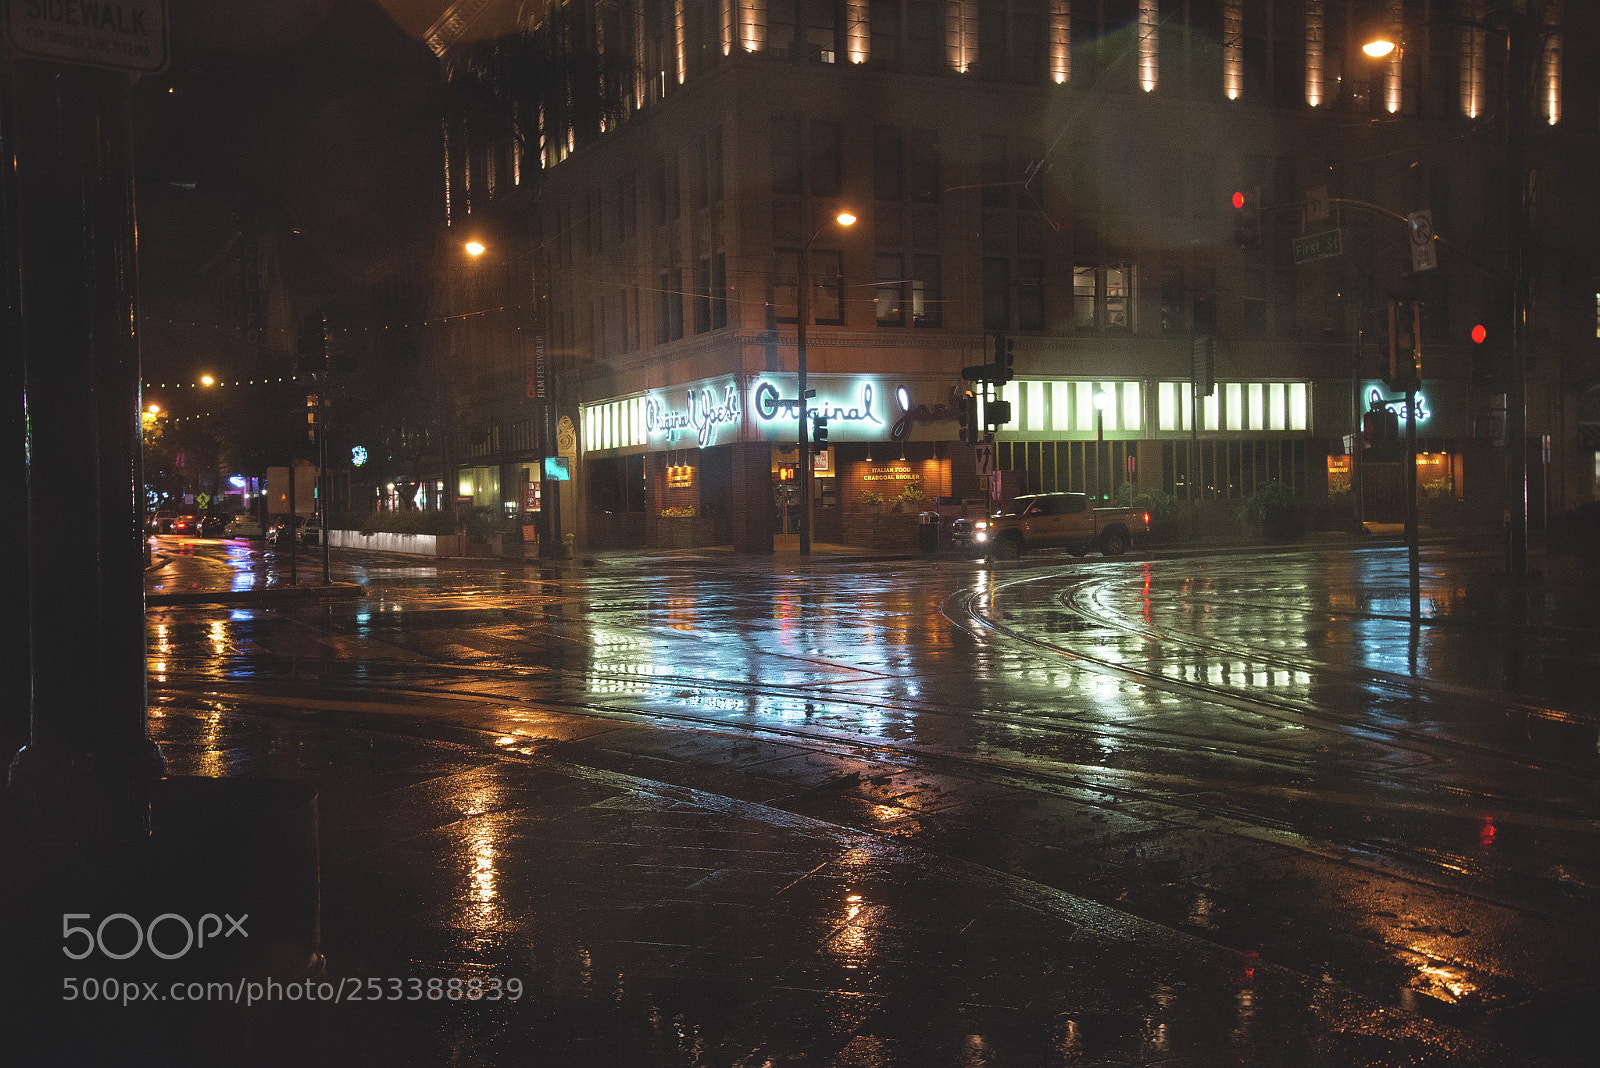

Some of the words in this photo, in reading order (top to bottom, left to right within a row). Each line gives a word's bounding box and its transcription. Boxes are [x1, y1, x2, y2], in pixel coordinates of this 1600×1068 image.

[27, 0, 147, 36] SIDEWALK
[1296, 240, 1320, 257] First
[1326, 236, 1339, 250] St
[536, 345, 545, 378] FESTIVAL
[537, 380, 545, 398] FILM
[755, 381, 883, 424] Orinal
[646, 389, 697, 441] Original
